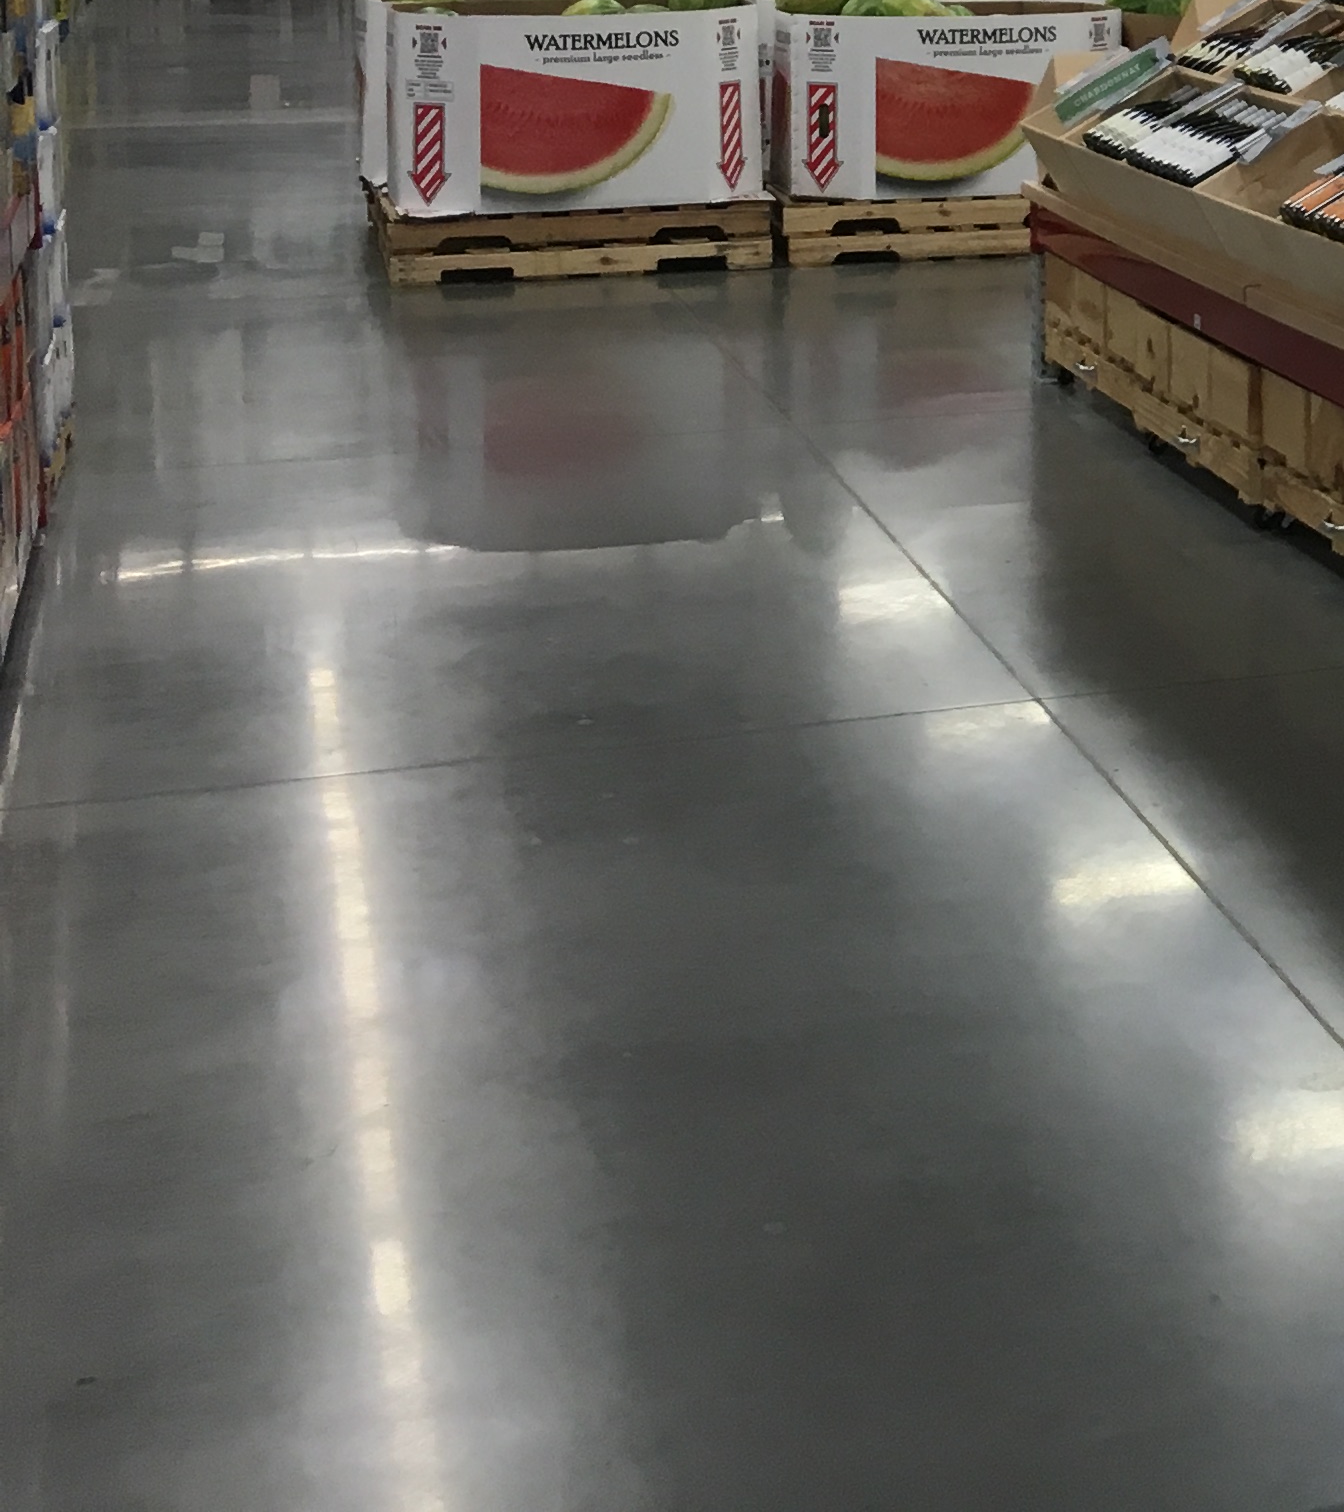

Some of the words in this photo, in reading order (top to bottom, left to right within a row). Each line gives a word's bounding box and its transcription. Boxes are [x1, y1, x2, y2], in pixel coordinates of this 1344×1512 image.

[525, 30, 679, 51] WATERMELONS
[917, 26, 1057, 45] WATERMELONS
[542, 54, 590, 64] premium
[592, 52, 620, 64] large
[979, 46, 1003, 57] large
[1073, 63, 1142, 107] CHARDONNAY
